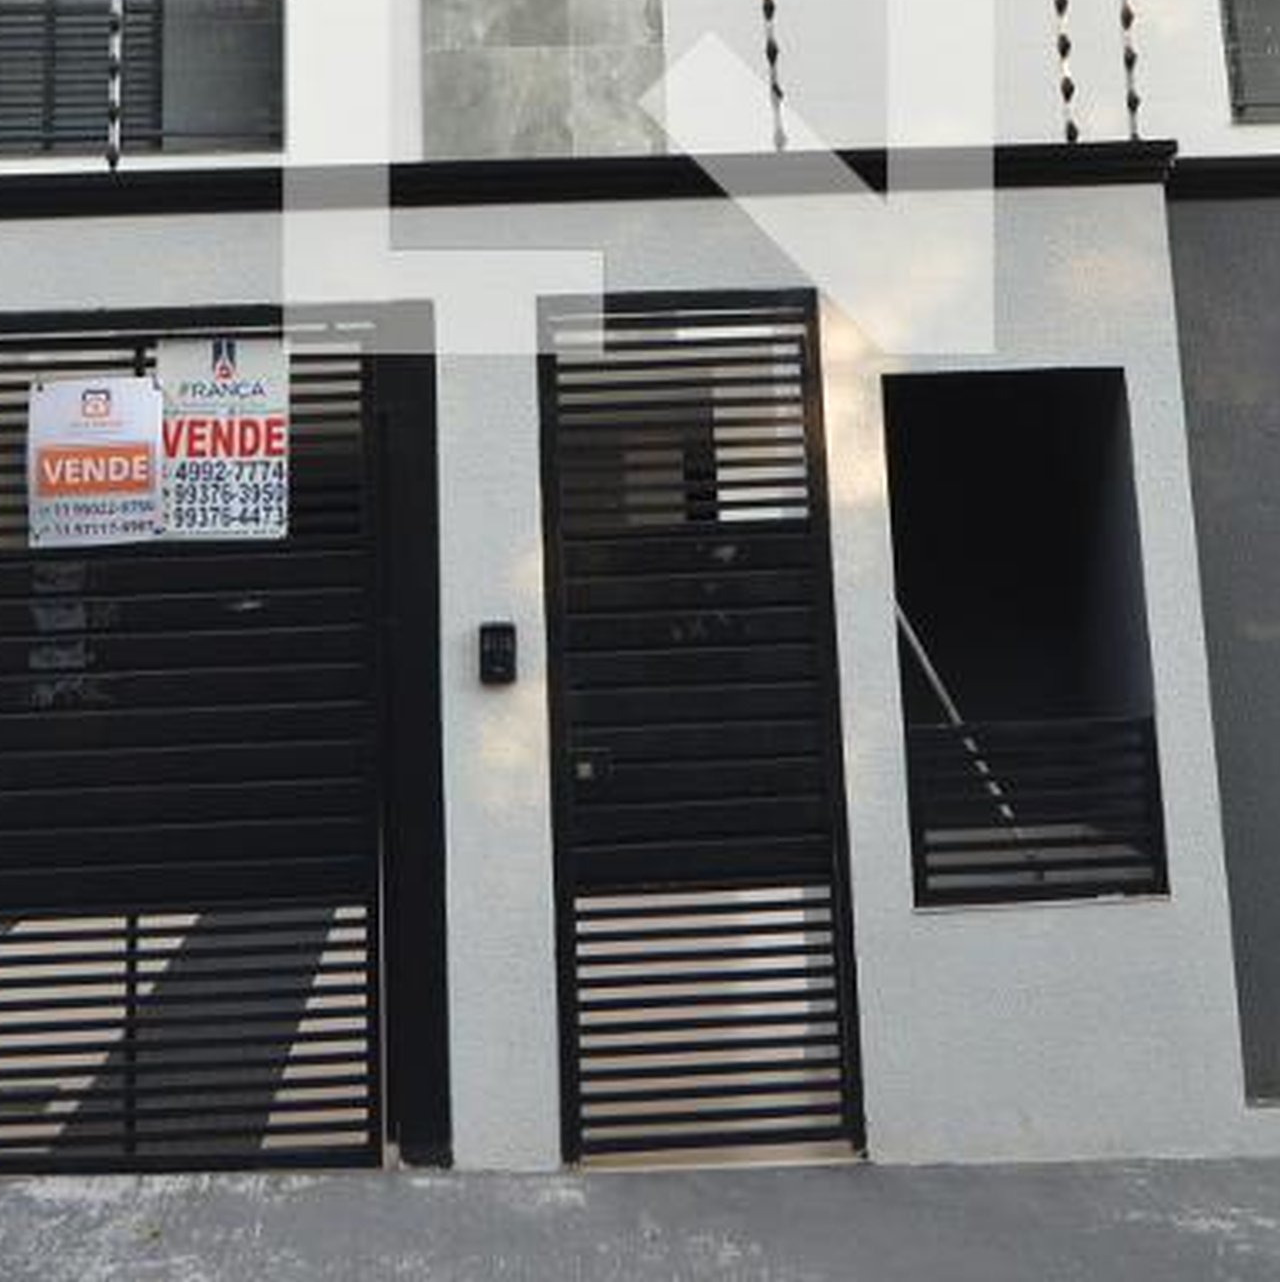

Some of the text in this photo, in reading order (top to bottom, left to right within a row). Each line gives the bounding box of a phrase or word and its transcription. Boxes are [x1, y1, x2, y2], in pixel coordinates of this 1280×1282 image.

[162, 418, 287, 459] VENDE
[42, 455, 149, 485] VENDE
[174, 460, 285, 482] 4992-7774
